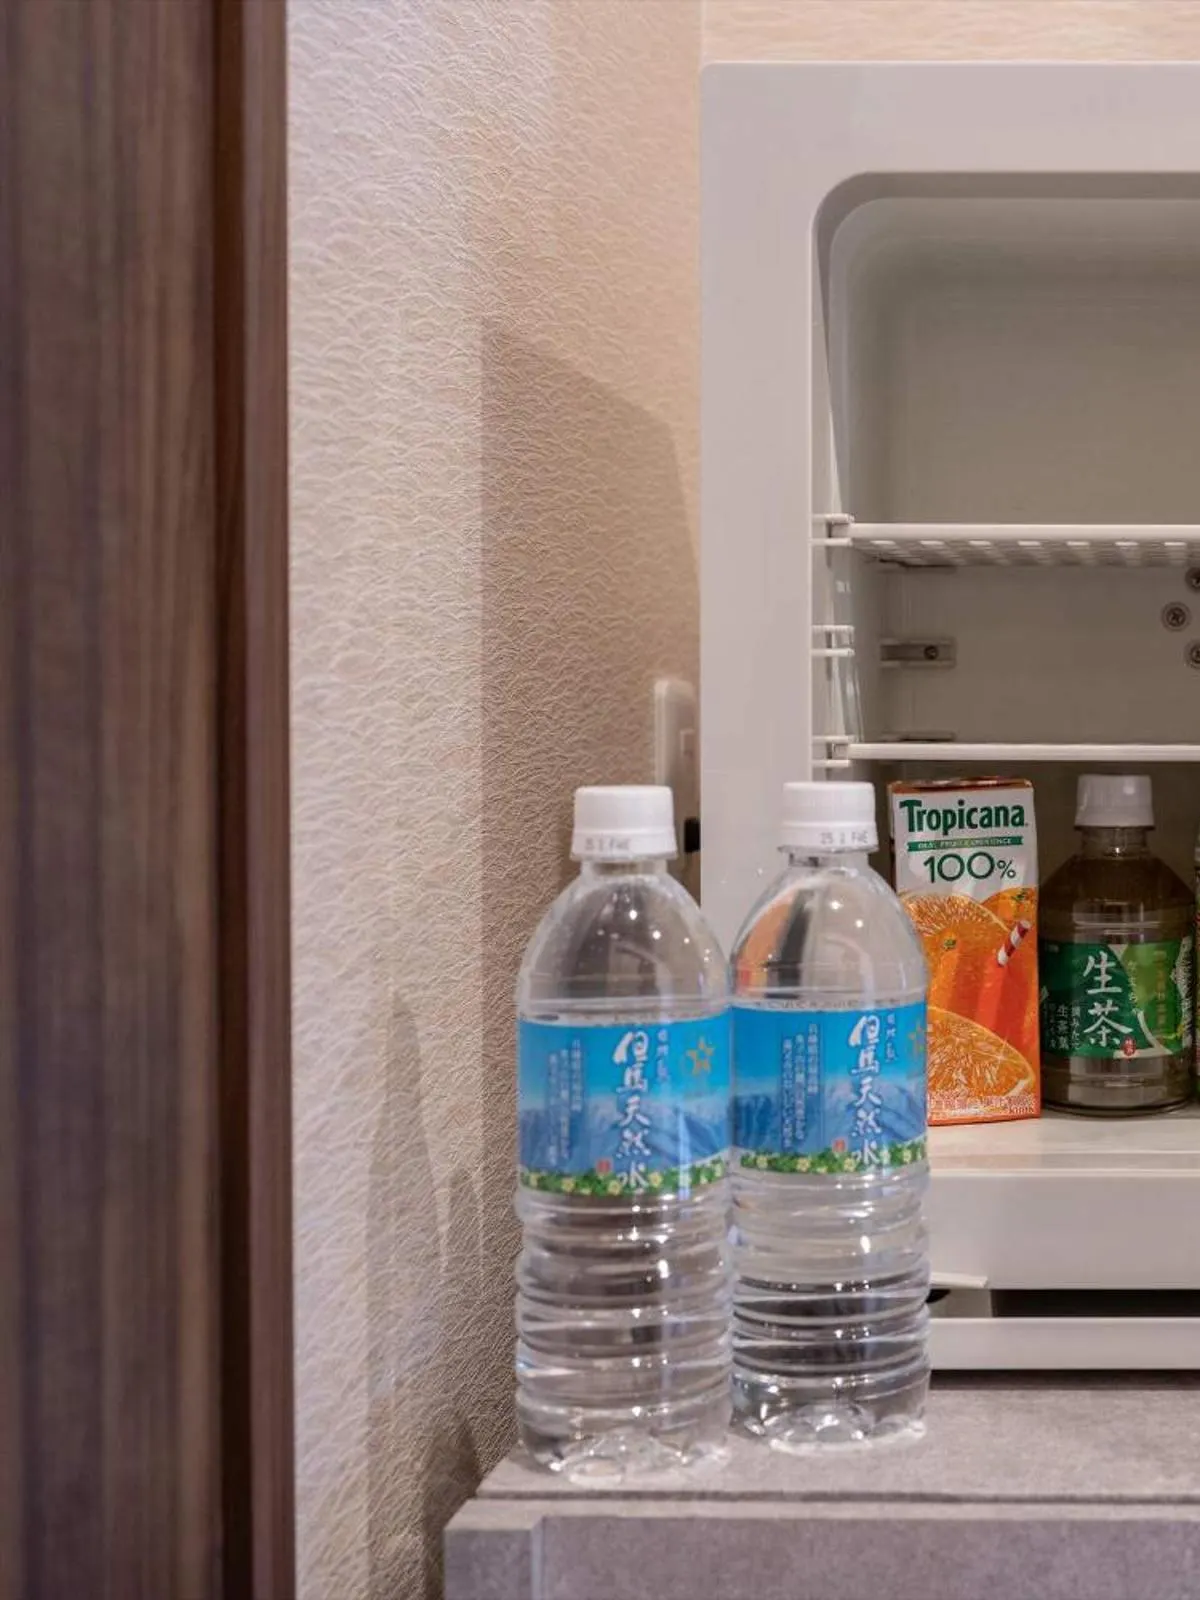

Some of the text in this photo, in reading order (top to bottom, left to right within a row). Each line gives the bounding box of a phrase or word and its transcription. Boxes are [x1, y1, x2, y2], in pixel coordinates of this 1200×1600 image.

[899, 799, 1025, 836] Tropicana
[923, 851, 1016, 884] 100%
[1083, 950, 1134, 1047] 生茶
